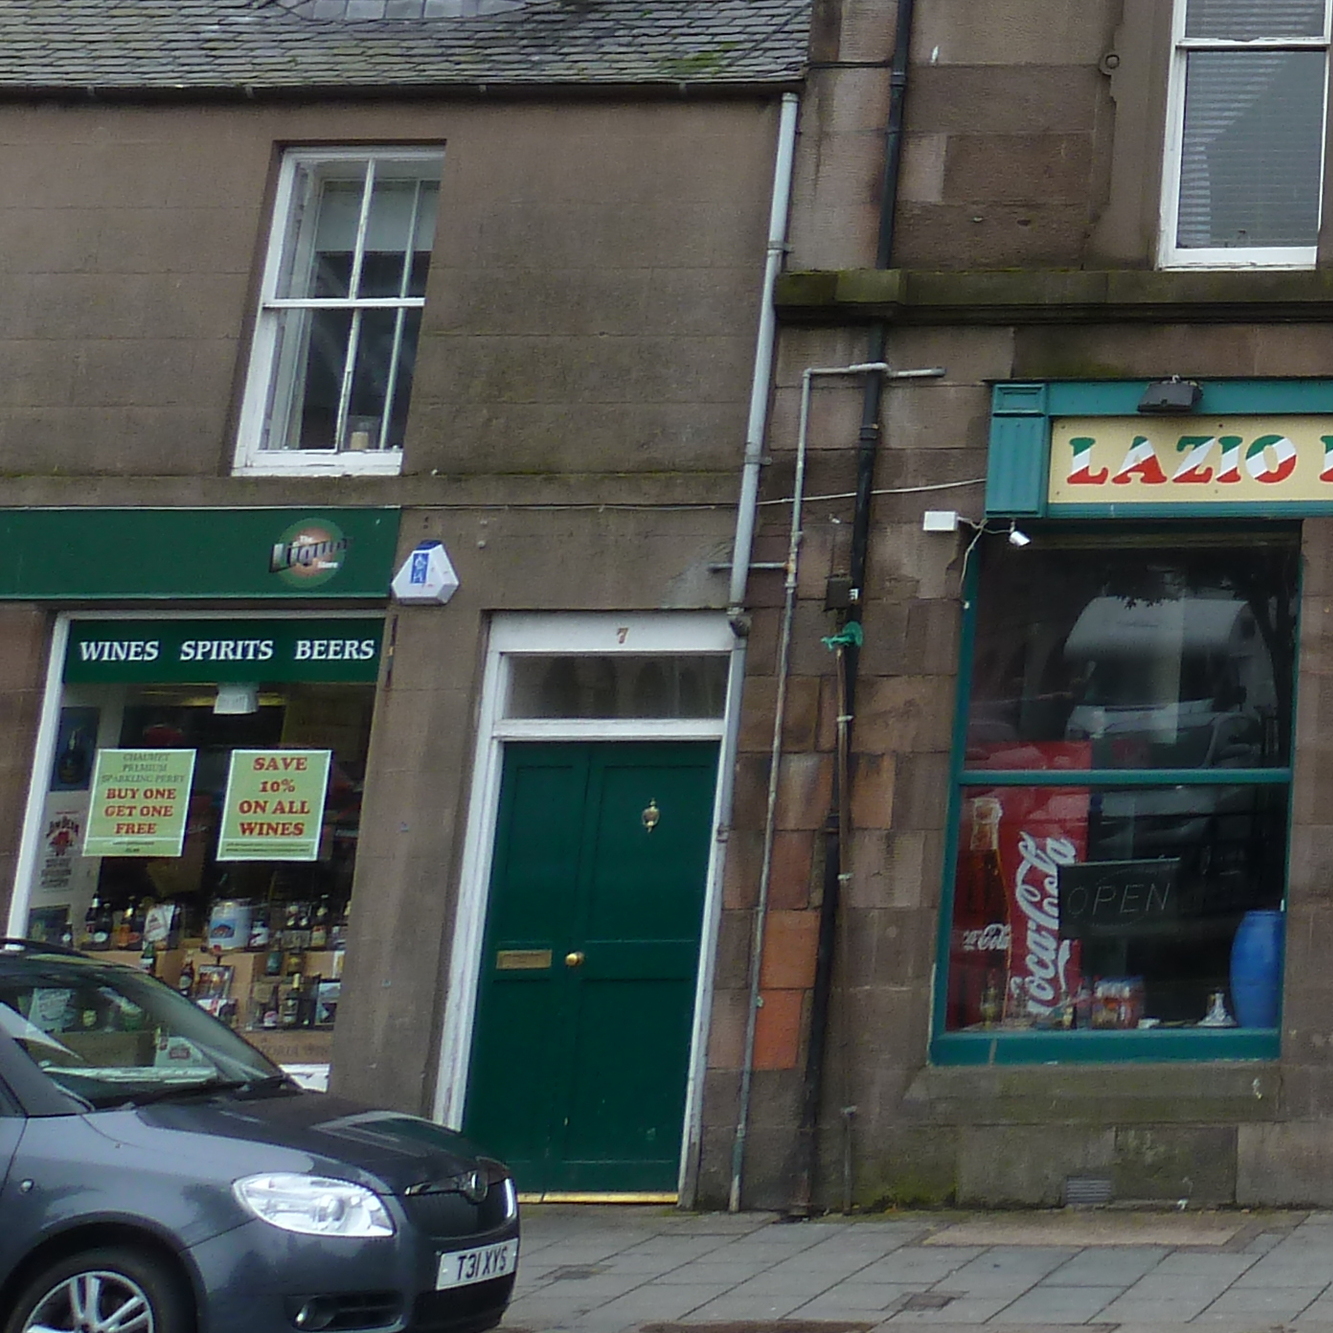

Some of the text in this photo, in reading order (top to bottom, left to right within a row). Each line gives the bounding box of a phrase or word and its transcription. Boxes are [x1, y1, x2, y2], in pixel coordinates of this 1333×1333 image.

[1066, 434, 1298, 485] LAZIO
[616, 627, 629, 644] 7
[80, 639, 375, 661] WINES SPIRITS BEERS
[253, 757, 308, 771] SAVE
[259, 778, 296, 793] 10%
[106, 788, 177, 800] BUY ONE
[104, 806, 174, 817] GET ONE
[238, 800, 311, 814] ON ALL
[115, 823, 157, 835] FREE
[239, 822, 305, 836] WINES
[1067, 882, 1171, 919] OPEN
